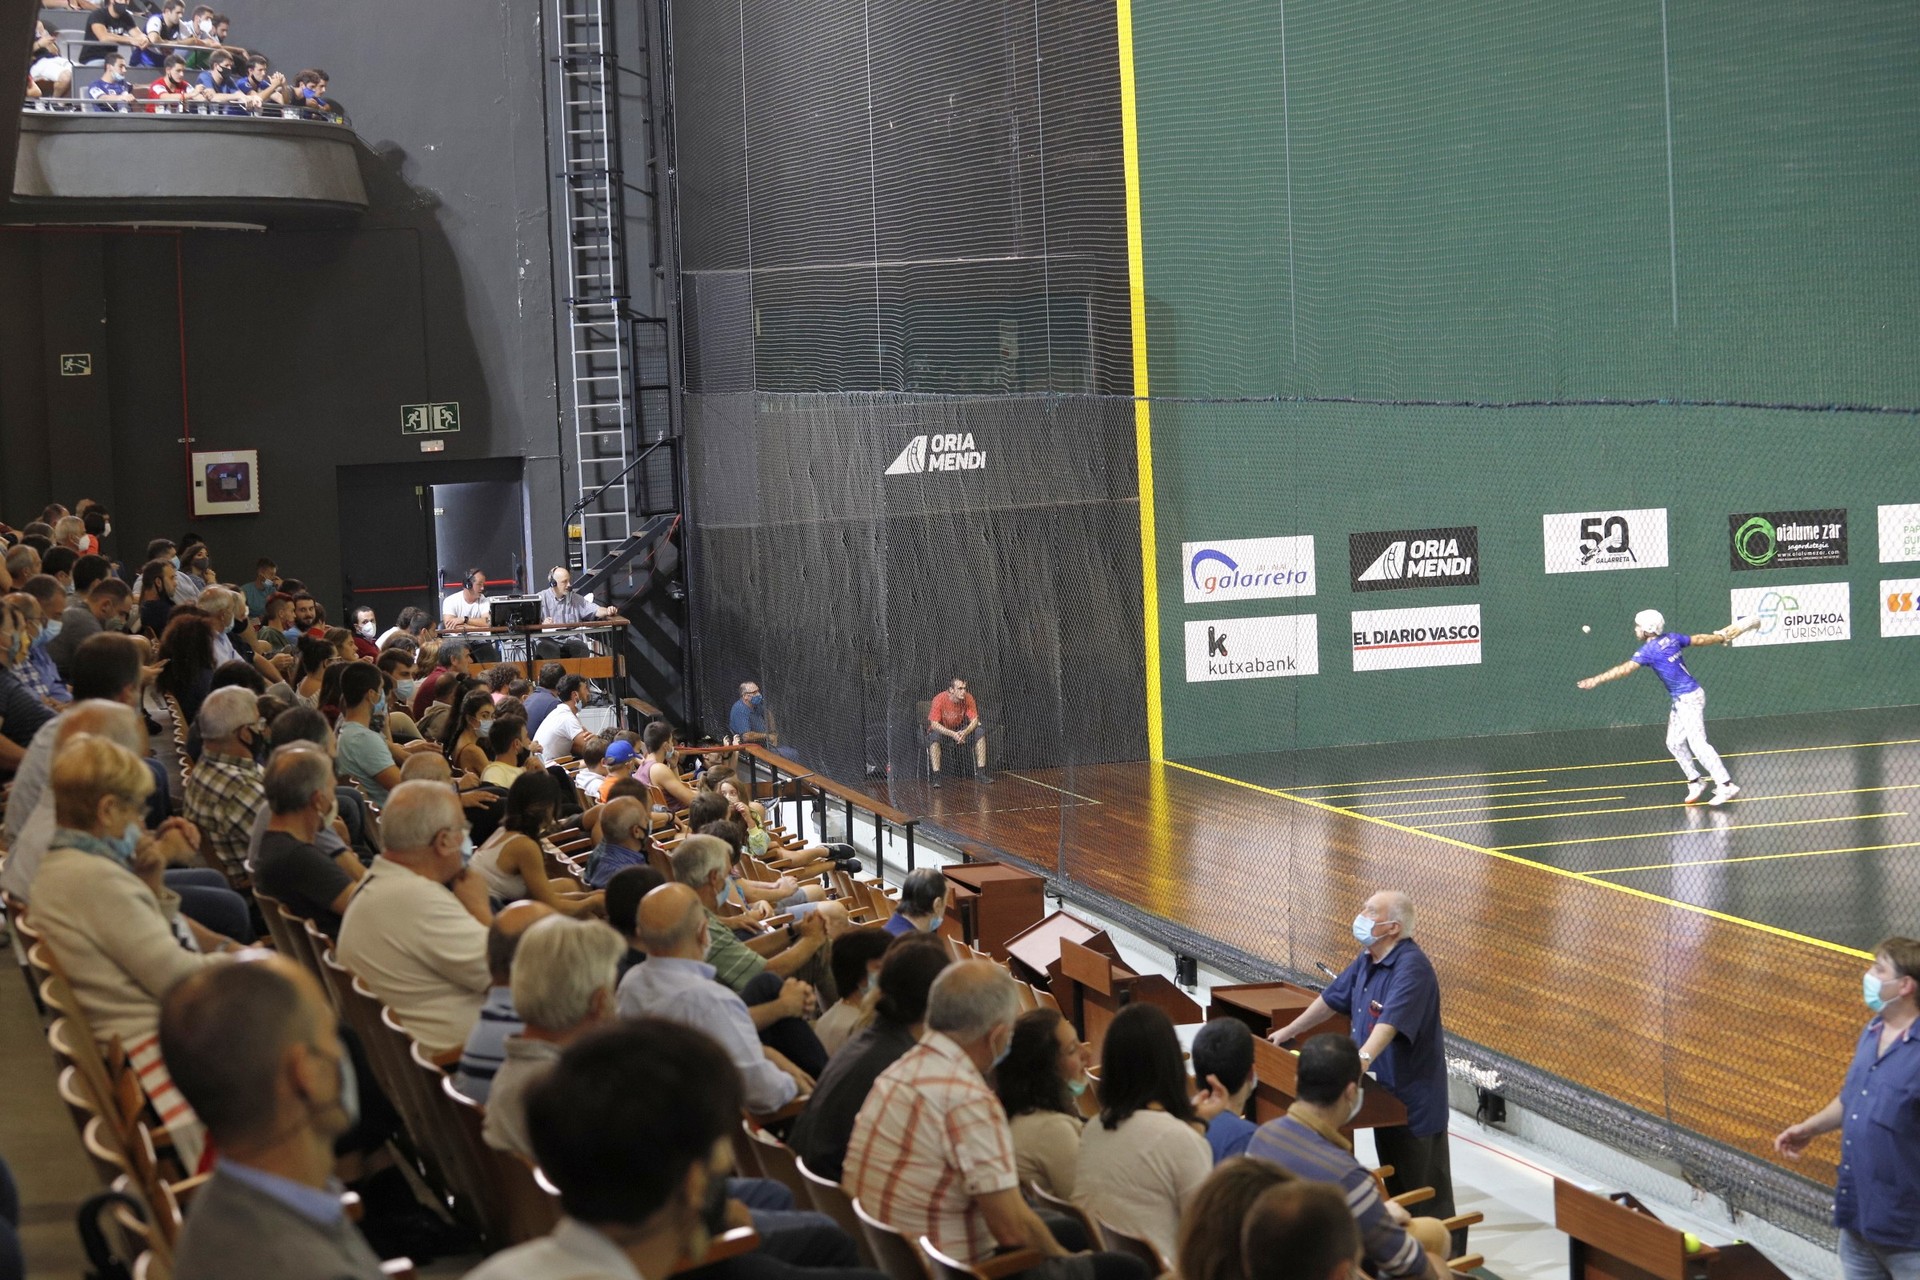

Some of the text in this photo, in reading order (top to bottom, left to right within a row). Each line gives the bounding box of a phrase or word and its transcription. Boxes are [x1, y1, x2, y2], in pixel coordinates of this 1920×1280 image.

[931, 432, 976, 453] ORIA
[928, 450, 987, 472] MENDI
[1579, 516, 1630, 556] 50
[1776, 522, 1842, 542] oialume zar
[1410, 538, 1459, 559] ORIA
[1407, 557, 1472, 578] MENDI
[1596, 556, 1630, 564] GALARRETA
[1204, 569, 1307, 594] galarreta
[1784, 613, 1845, 626] GIPUZKOA
[1353, 625, 1480, 645] EL DIARIO VASCO
[1784, 626, 1843, 638] TURISMOA
[1209, 655, 1297, 675] kutxabank
